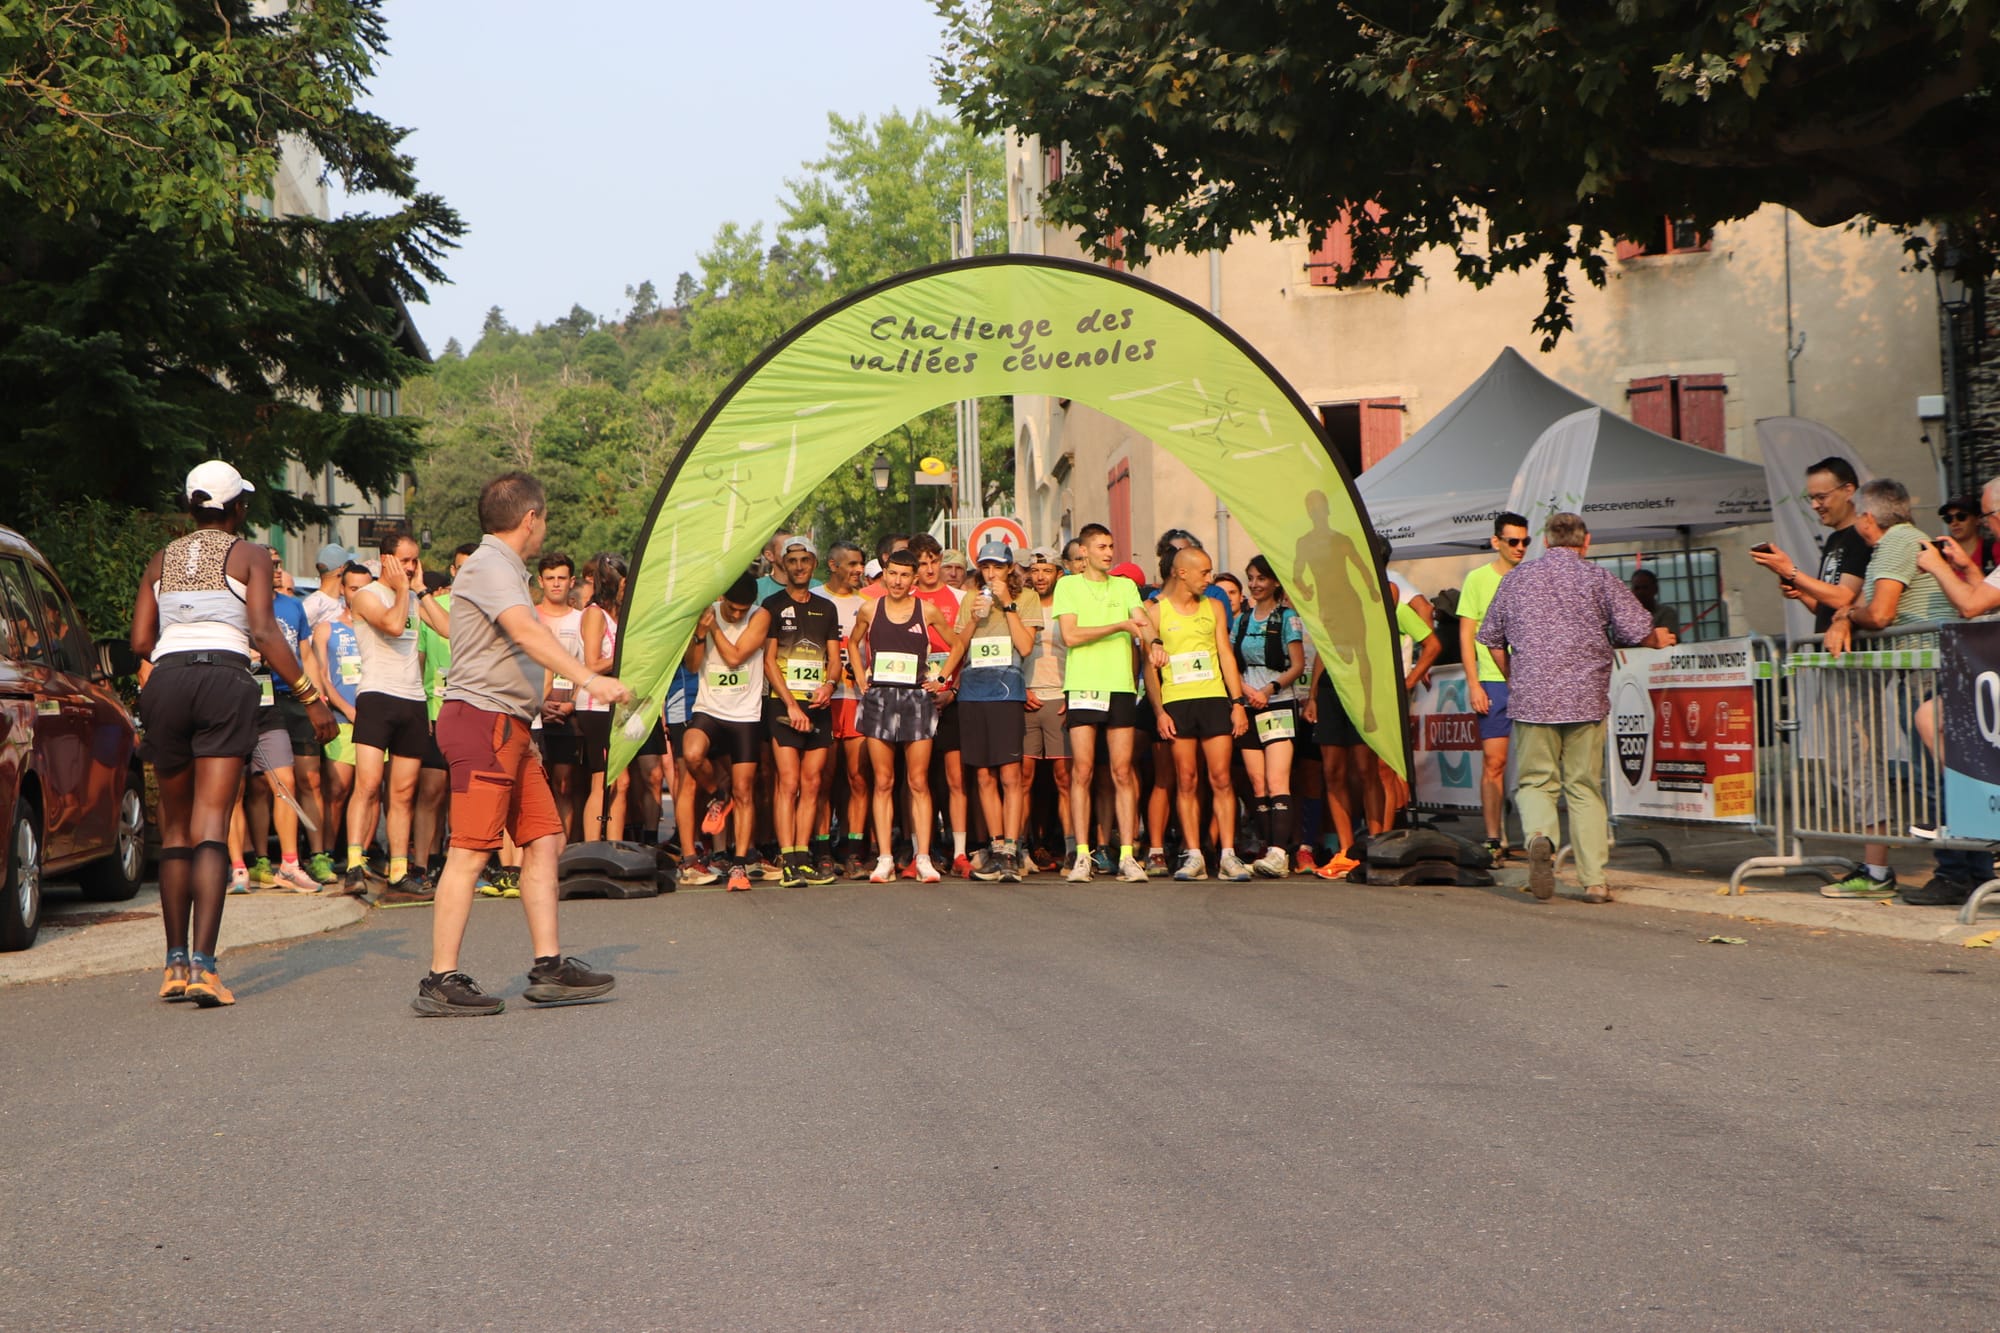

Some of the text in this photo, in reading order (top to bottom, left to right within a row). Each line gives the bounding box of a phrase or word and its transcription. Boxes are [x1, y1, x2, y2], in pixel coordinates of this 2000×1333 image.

[870, 308, 1134, 349] Challenge des
[849, 338, 1157, 374] vallées cévenoles
[981, 645, 1000, 657] 93
[1670, 655, 1697, 670] SPORT
[718, 673, 739, 686] 20
[793, 667, 820, 681] 124
[1265, 717, 1282, 730] 17
[1617, 714, 1646, 732] SPORT
[1429, 717, 1476, 746] QUÉZAC
[1619, 737, 1645, 755] 2000
